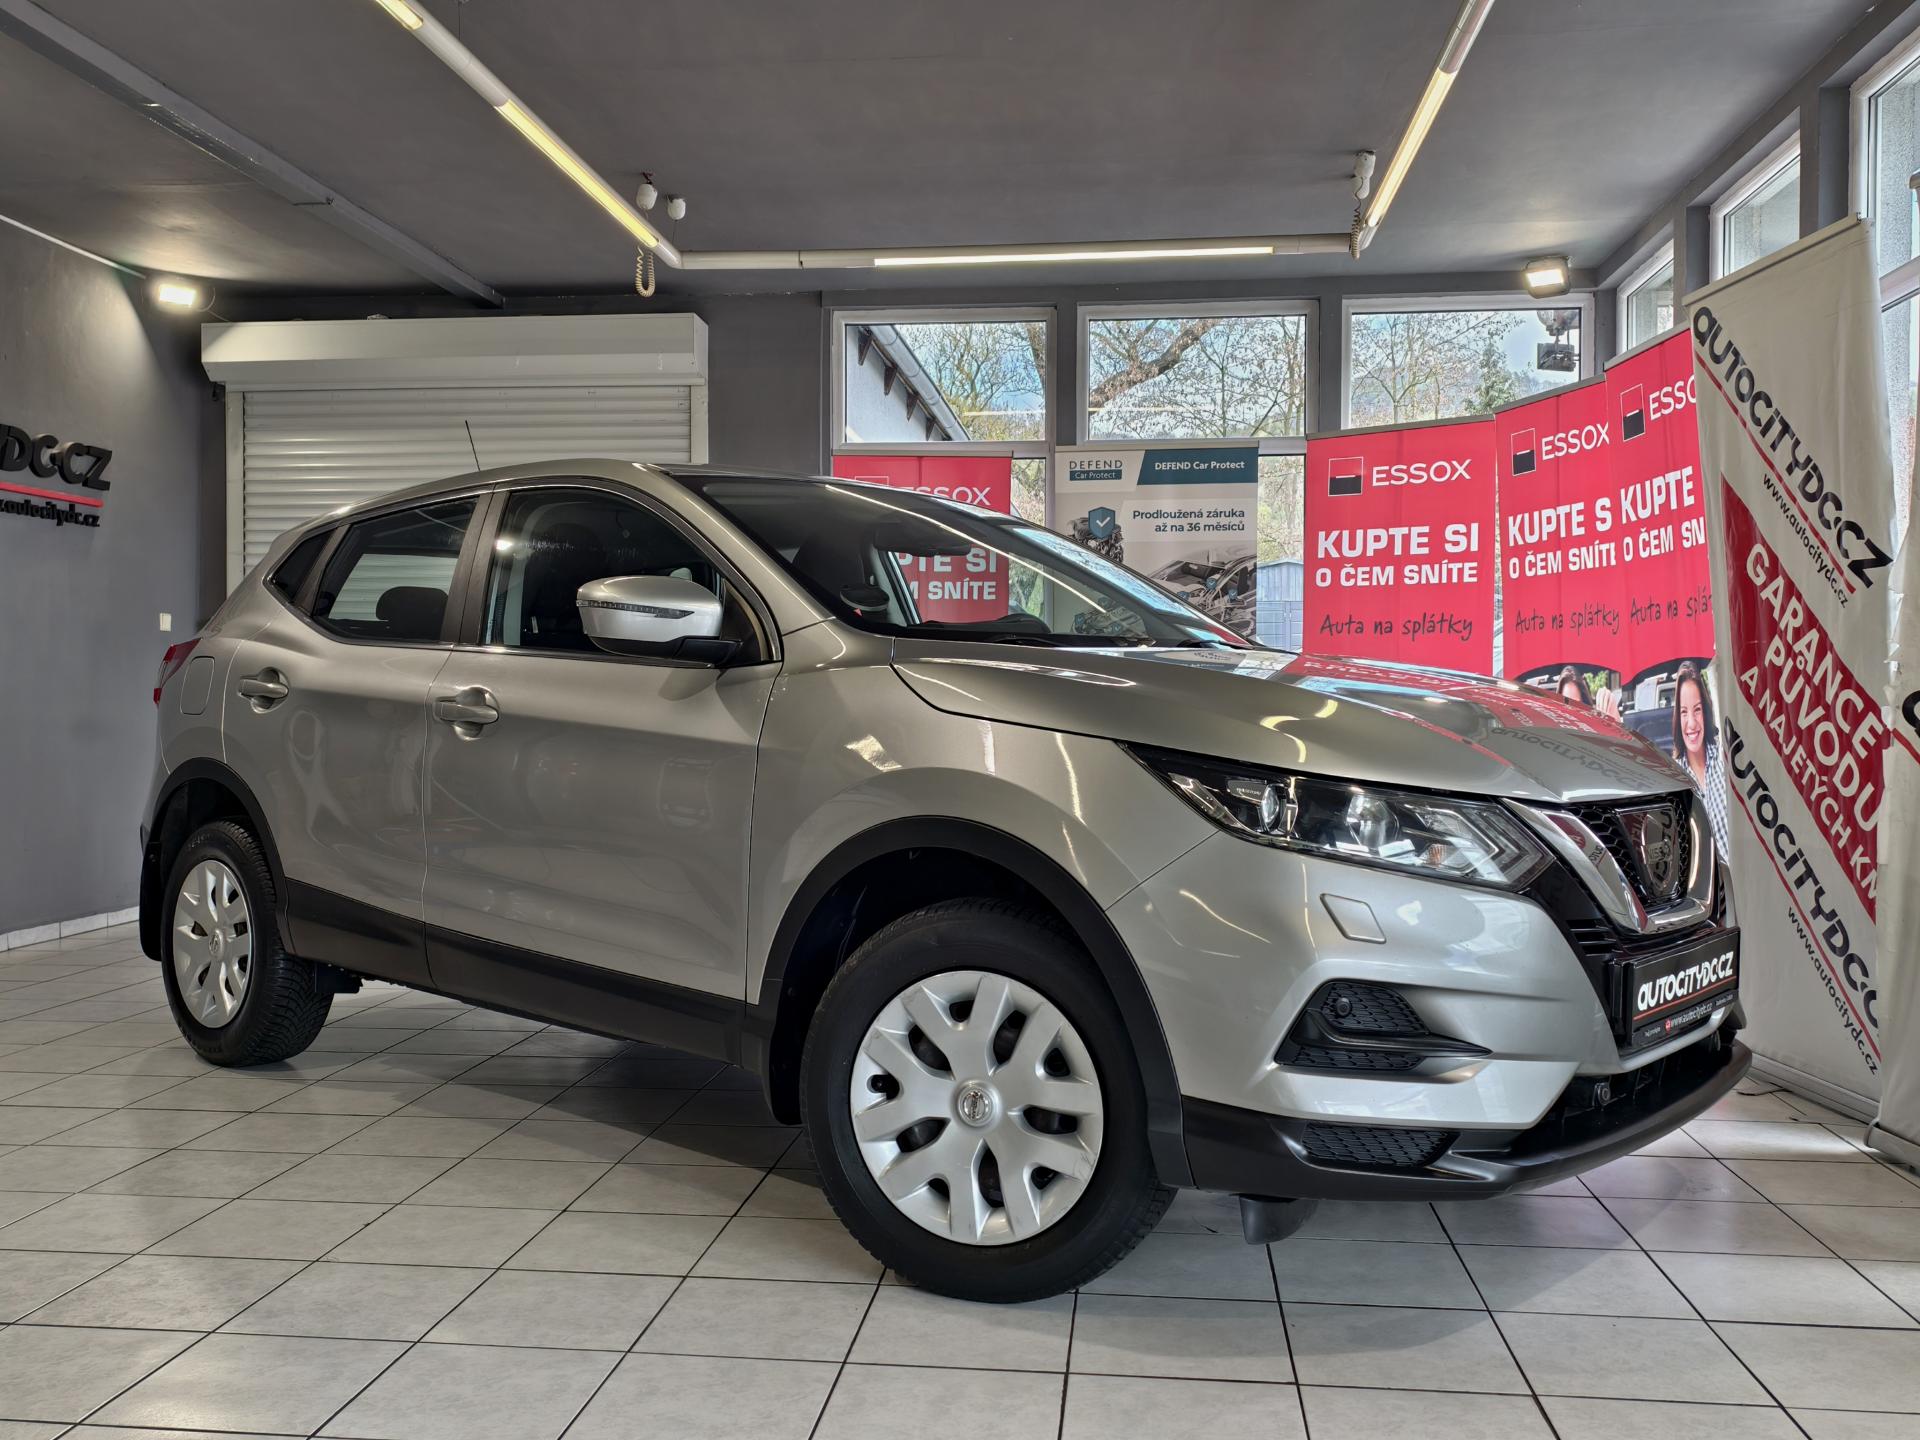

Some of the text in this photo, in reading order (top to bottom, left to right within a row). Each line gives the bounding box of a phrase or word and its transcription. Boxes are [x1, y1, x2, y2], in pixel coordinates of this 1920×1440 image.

[1649, 375, 1697, 421] ESSO
[1541, 421, 1610, 461] ESSOX
[1069, 459, 1123, 470] DEFEND
[1089, 472, 1116, 480] Protect
[1155, 460, 1245, 470] DEFEND Car Protect
[1372, 459, 1472, 487] ESSOX
[1620, 465, 1695, 524] KUPTE
[1133, 508, 1245, 520] Prodloužená záruka
[1154, 520, 1245, 532] až na 36 měsíců
[1508, 497, 1612, 547] KUPTE S
[1317, 522, 1479, 559] KUPTE SI
[1623, 516, 1706, 562] O ČEM SN
[1762, 472, 1849, 609] www.autocitydc.cz
[966, 547, 997, 573] SI
[1315, 559, 1478, 588] O ČEM SNÍTE
[1508, 557, 1520, 579] O
[1524, 550, 1562, 577] ČEM
[928, 577, 997, 600] SNÍTE
[1515, 602, 1620, 636] Auta na splátky
[1630, 597, 1661, 624] Auta
[1666, 600, 1678, 618] na
[1320, 612, 1473, 642] Auta na splátky
[1746, 543, 1885, 759] GARANCE
[1764, 634, 1880, 832] PŮVODU
[1740, 666, 1759, 696] A
[1758, 688, 1852, 849] NAJETÝCH
[1787, 906, 1878, 1075] www.autocitydc.cz
